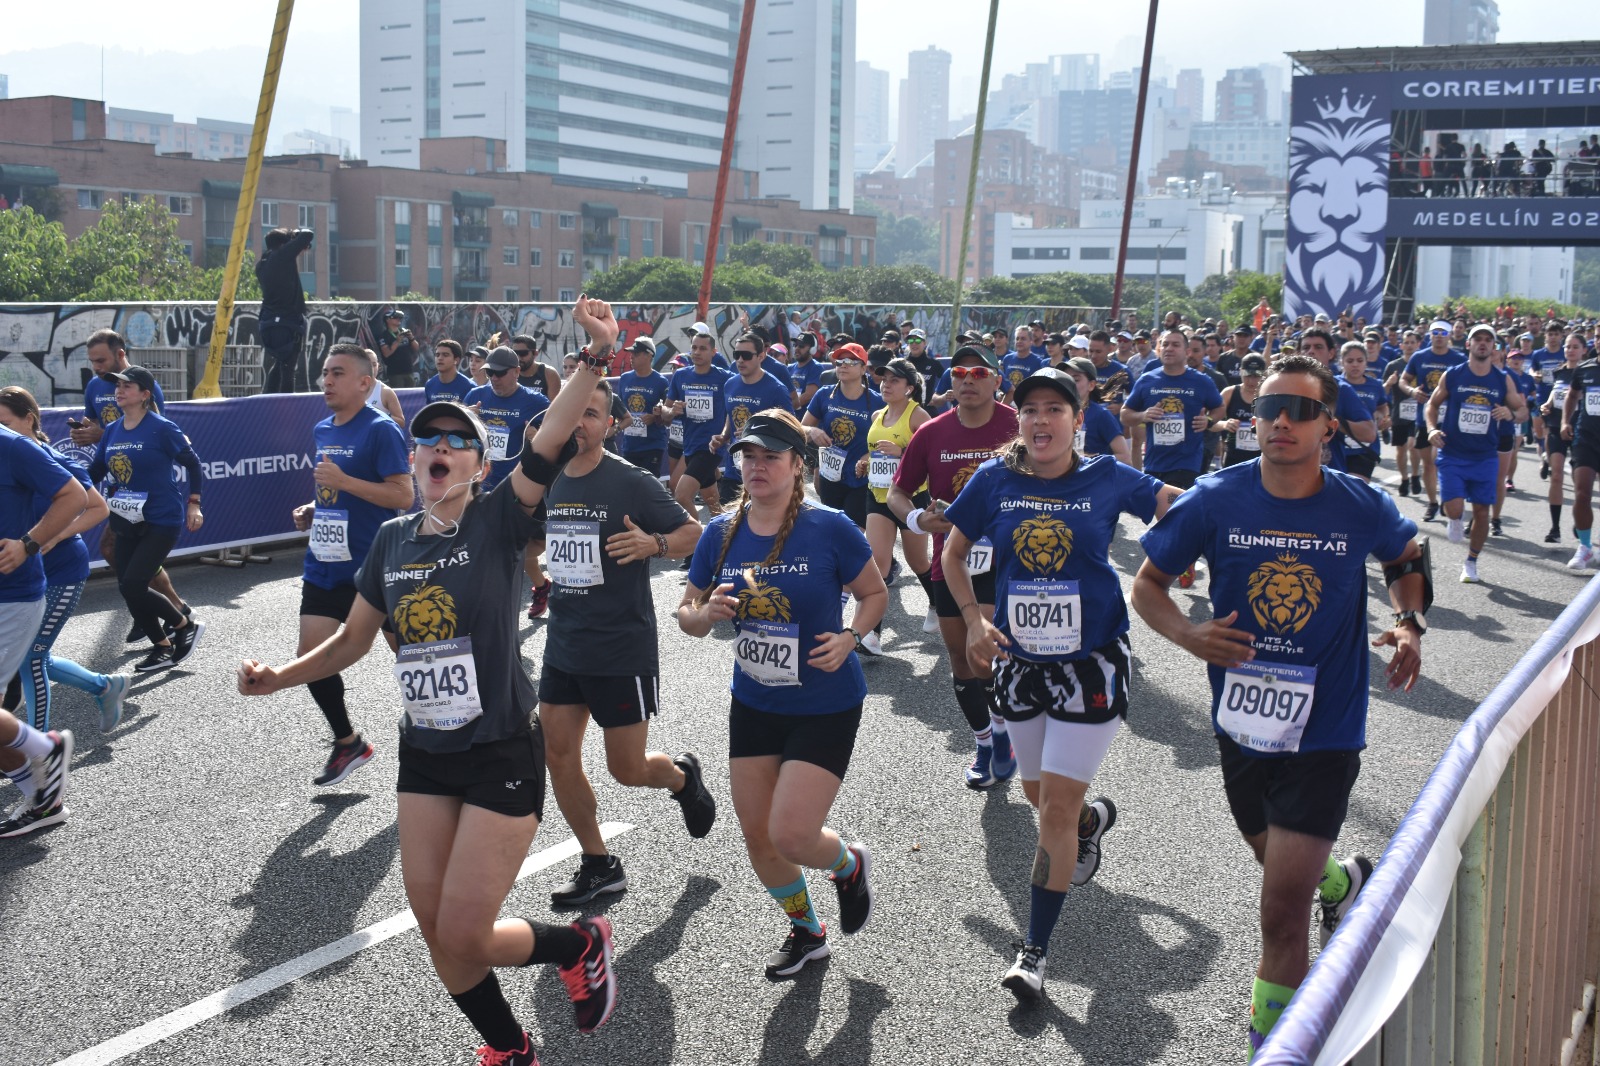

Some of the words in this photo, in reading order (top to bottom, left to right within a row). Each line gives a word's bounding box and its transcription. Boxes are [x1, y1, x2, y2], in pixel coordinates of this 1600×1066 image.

[1413, 208, 1540, 226] MEDELLÍN
[687, 399, 710, 410] 32179
[1461, 412, 1488, 425] 30130
[1155, 423, 1182, 434] 08432
[872, 461, 899, 475] 08810
[1000, 500, 1091, 511] RUNNERSTAR
[1260, 529, 1318, 539] CORREMITIERRA
[1330, 532, 1348, 540] STYLE
[1229, 534, 1347, 552] RUNNERSTAR
[550, 539, 593, 564] 24011
[1015, 602, 1073, 628] 08741
[401, 643, 459, 656] CORREMITIERRA
[737, 637, 792, 670] 08742
[400, 664, 469, 702] 32143
[1227, 682, 1309, 723] 09097
[434, 719, 451, 727] VIVE
[1251, 737, 1269, 748] VIVE
